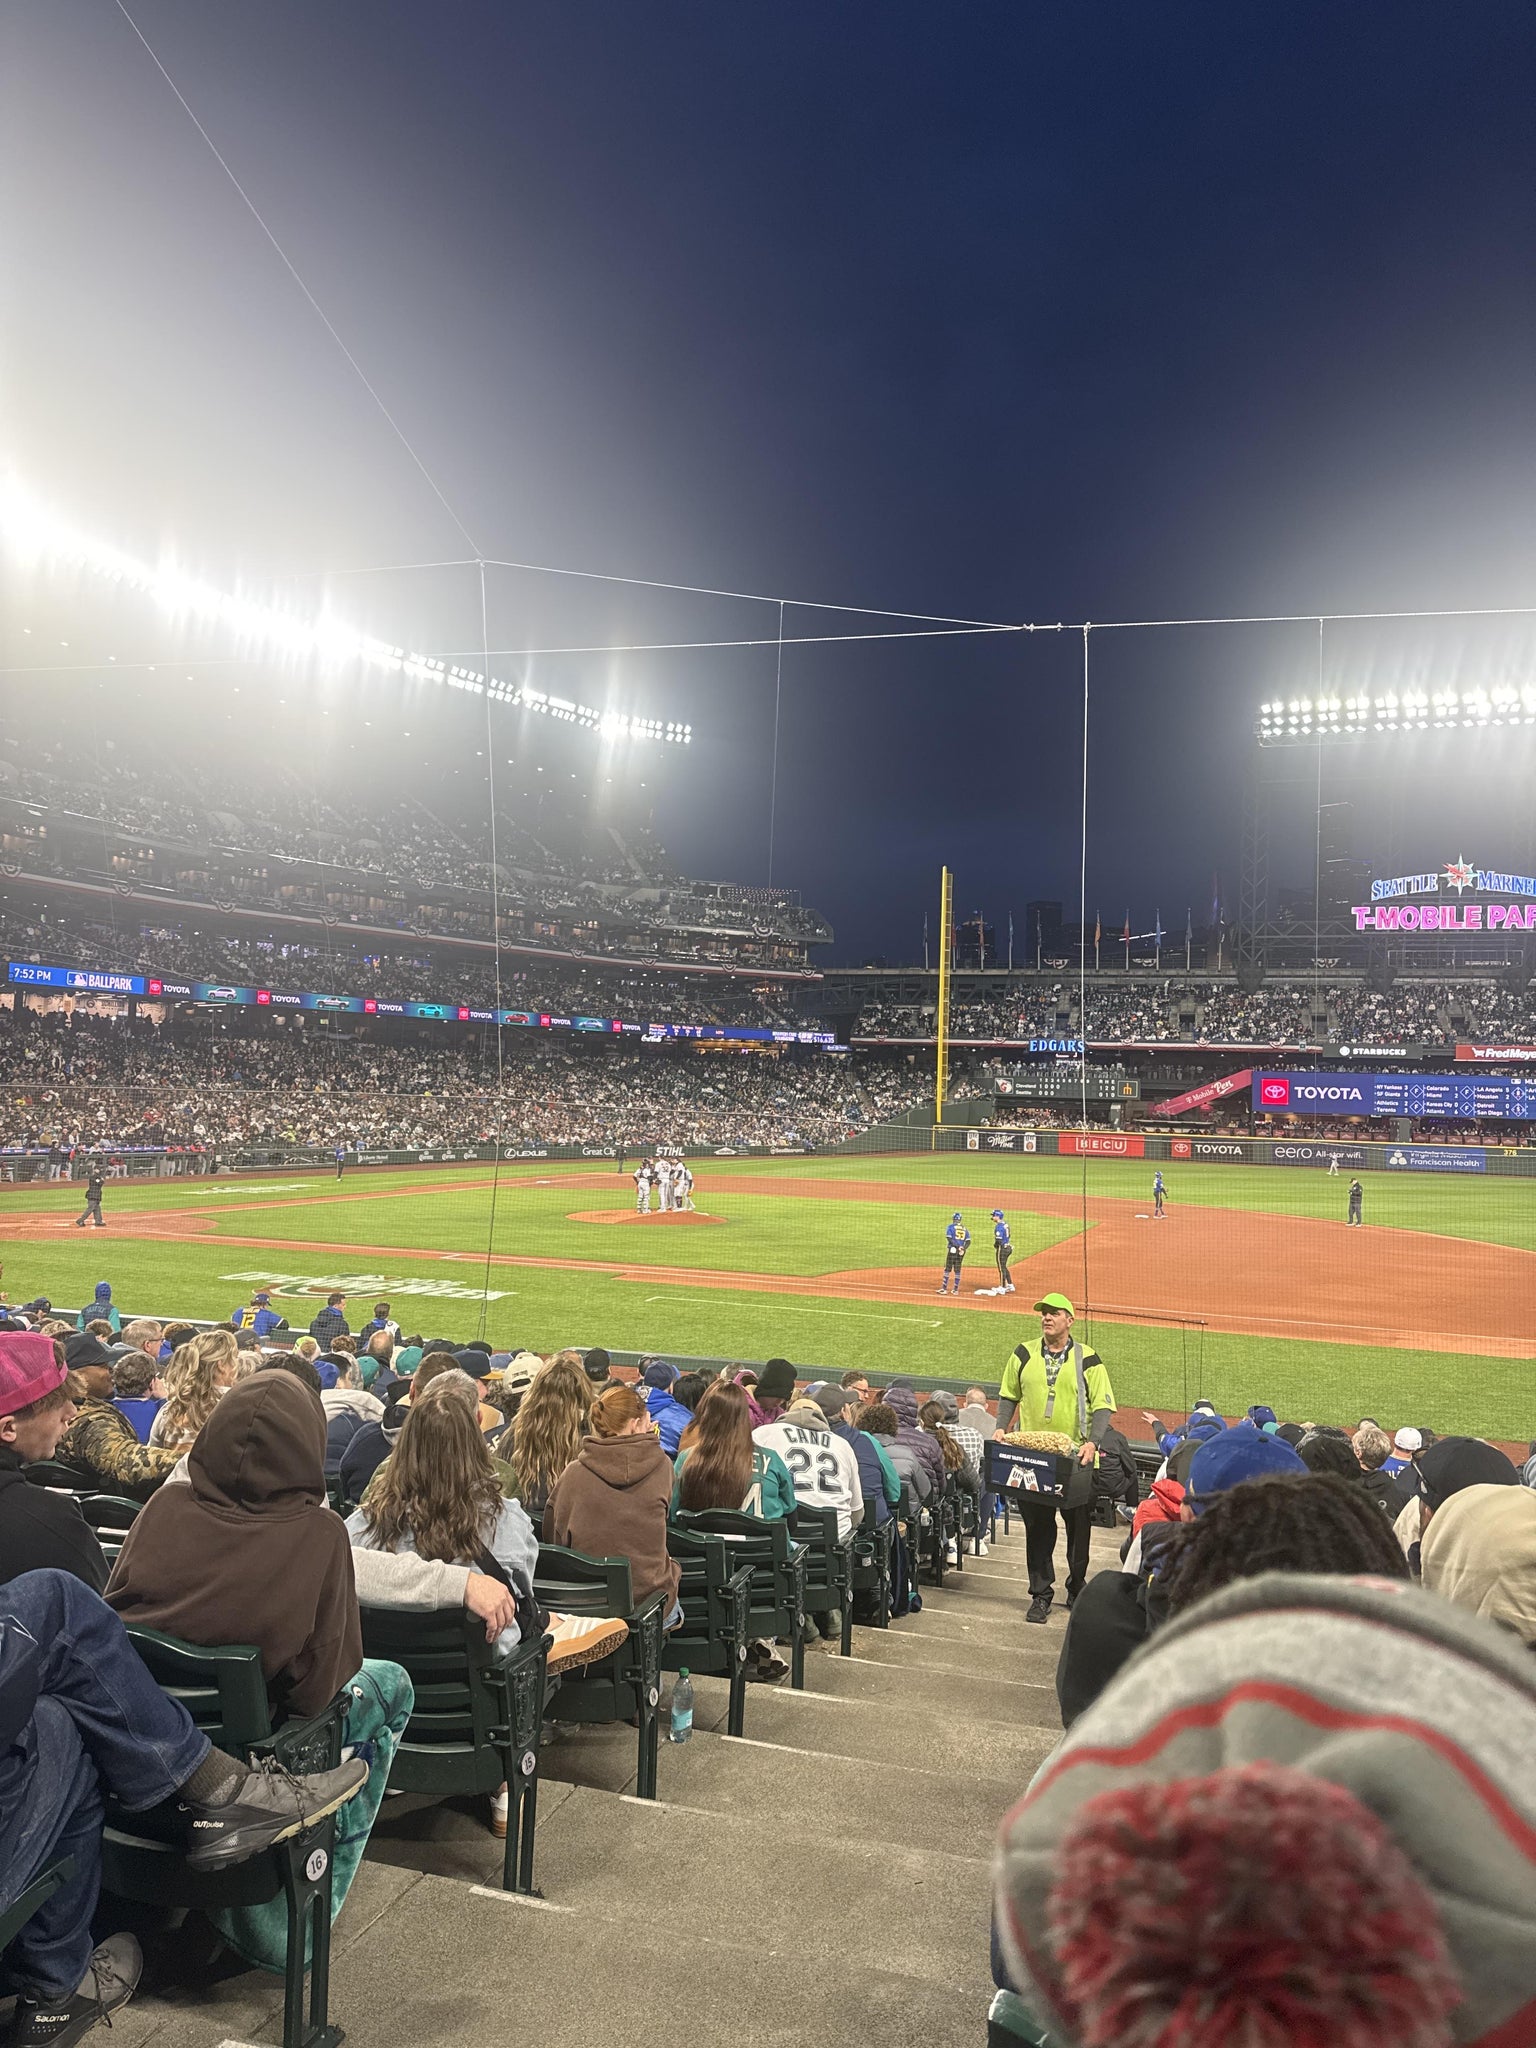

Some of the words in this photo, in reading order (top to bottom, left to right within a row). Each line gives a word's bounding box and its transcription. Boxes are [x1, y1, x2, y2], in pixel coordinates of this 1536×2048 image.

[1371, 873, 1438, 901] SEATTLE
[1351, 905, 1482, 930] T-MOBILE
[14, 968, 35, 979] 7:52
[37, 970, 51, 981] PM
[88, 974, 133, 991] BALLPARK
[162, 984, 190, 994] TOYOTA
[272, 994, 301, 1004] TOYOTA
[377, 1003, 403, 1012] TOYOTA
[470, 1011, 492, 1019] TOYOTA
[551, 1018, 571, 1026] TOYOTA
[1352, 1048, 1407, 1056] STARBUCKS
[1294, 1086, 1363, 1100] TOYOTA
[1080, 1138, 1123, 1149] BECU
[582, 1147, 603, 1156] Great
[603, 1147, 617, 1157] Clip
[655, 1147, 685, 1157] STIHL
[1195, 1144, 1243, 1155] TOYOTA
[1274, 1147, 1313, 1159] eero
[1410, 1158, 1452, 1166] Franciscan
[240, 1313, 256, 1329] 12
[783, 1427, 832, 1449] CANO
[785, 1446, 843, 1494] 22
[524, 1757, 533, 1771] 15
[192, 1820, 225, 1829] OUTpulse
[310, 1855, 322, 1874] 16
